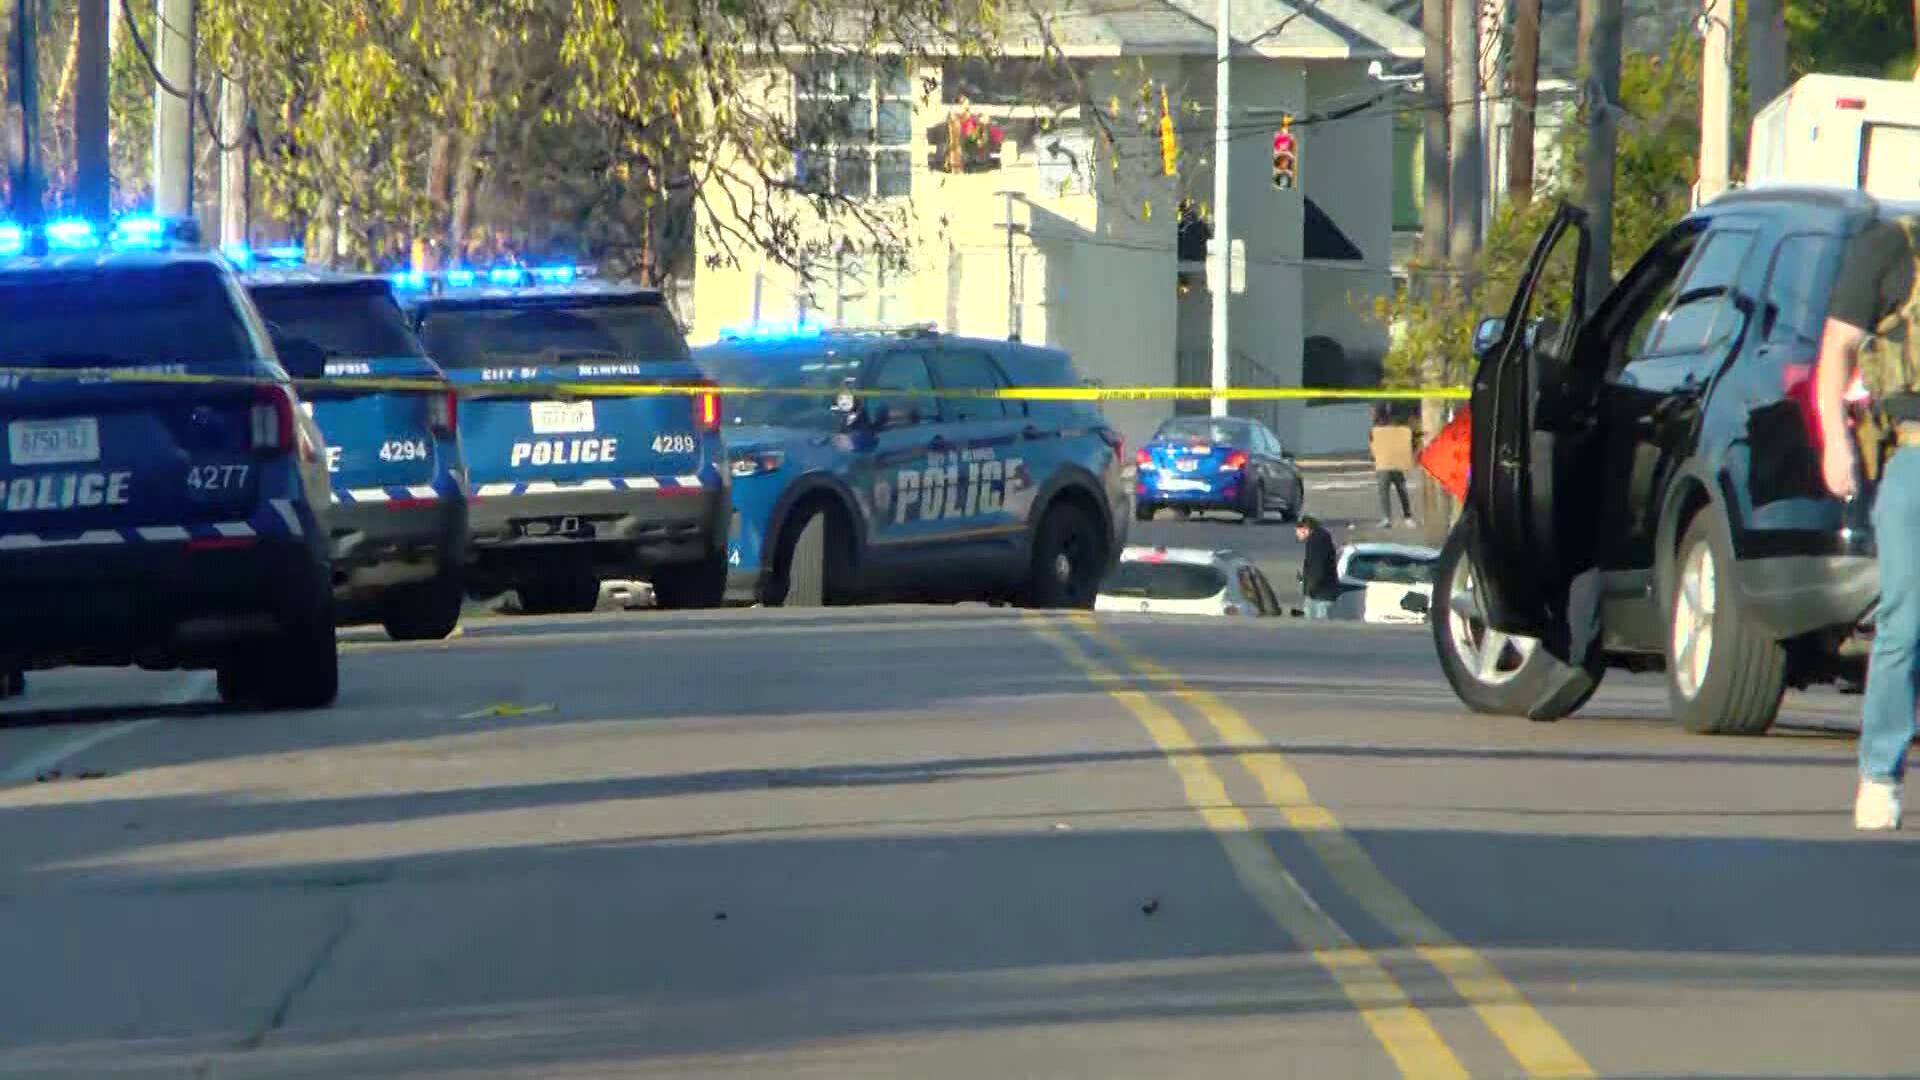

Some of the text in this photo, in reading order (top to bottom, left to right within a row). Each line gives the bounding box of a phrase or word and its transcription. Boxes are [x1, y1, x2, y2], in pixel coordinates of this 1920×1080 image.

[379, 441, 427, 462] 4294
[511, 438, 617, 467] POLICE
[651, 434, 695, 453] 4289
[187, 464, 249, 489] 4277
[895, 457, 1024, 524] POLICE
